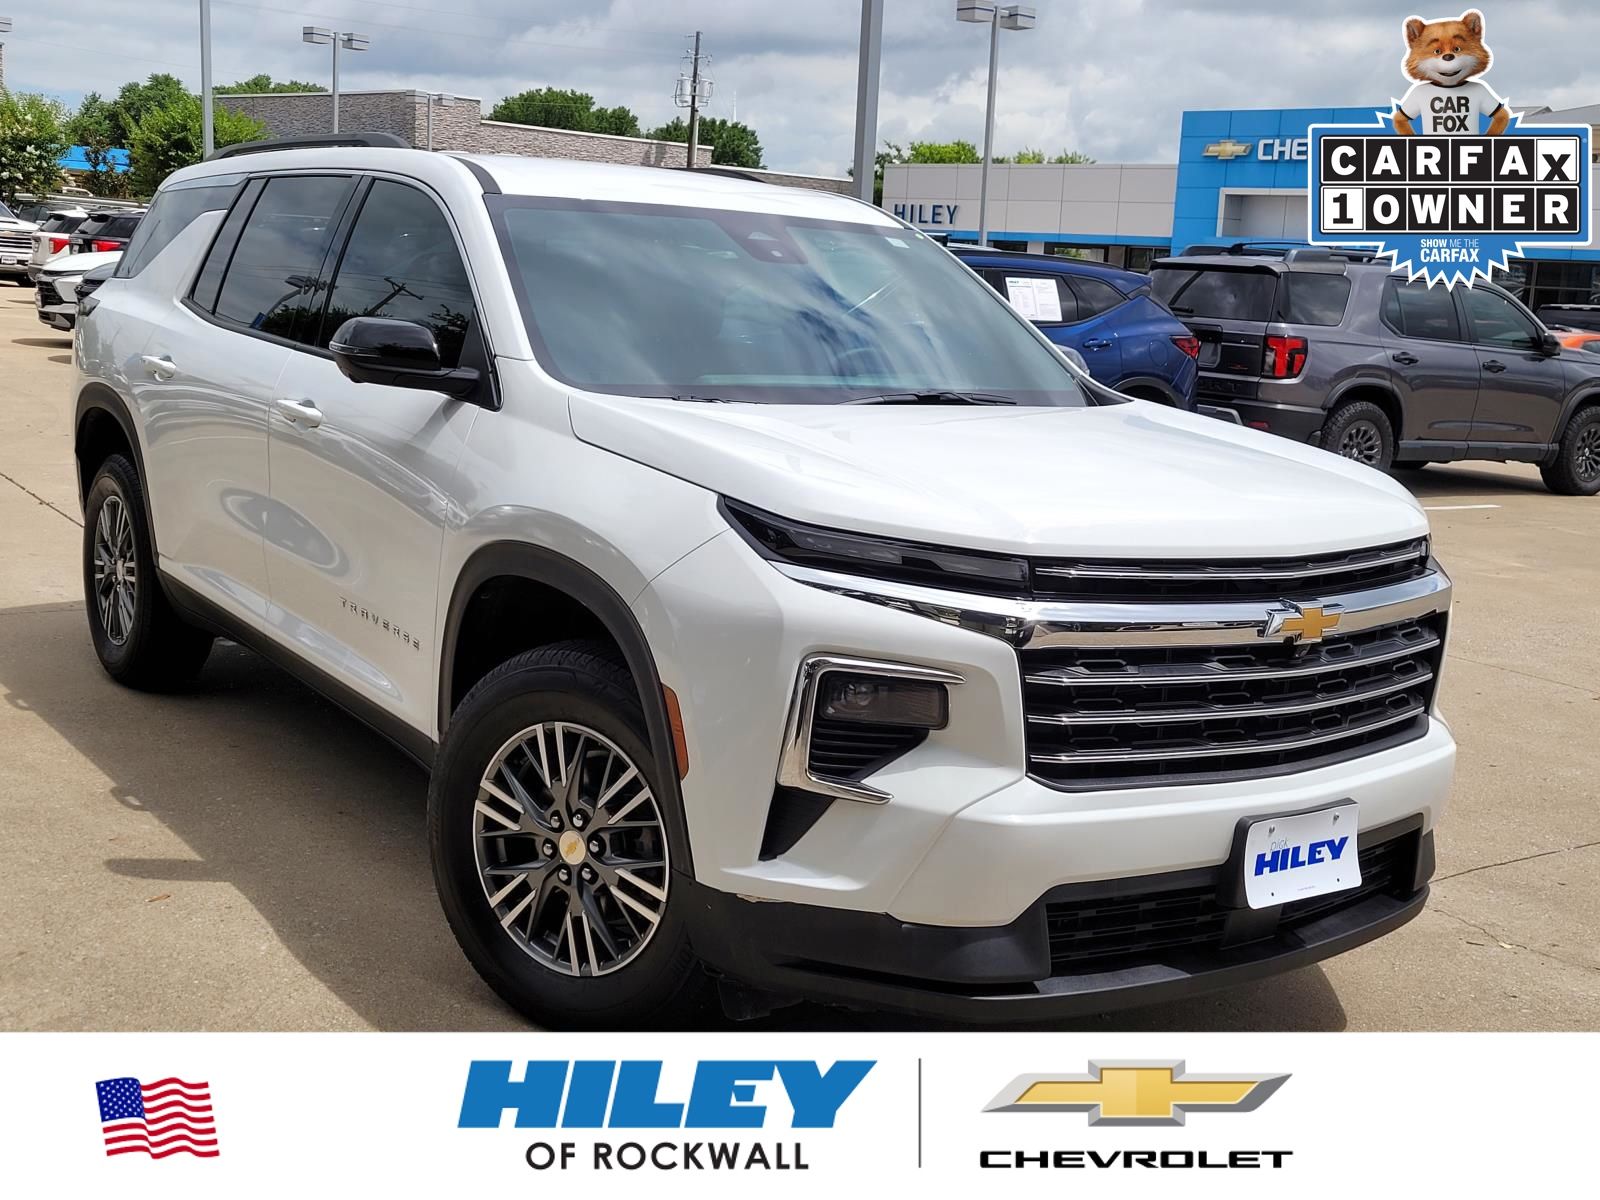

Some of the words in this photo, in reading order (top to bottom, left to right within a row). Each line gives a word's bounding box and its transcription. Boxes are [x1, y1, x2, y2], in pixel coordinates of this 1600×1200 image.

[894, 203, 959, 225] HILEY
[338, 597, 420, 650] TRAVERSE
[1254, 836, 1349, 877] HILEY
